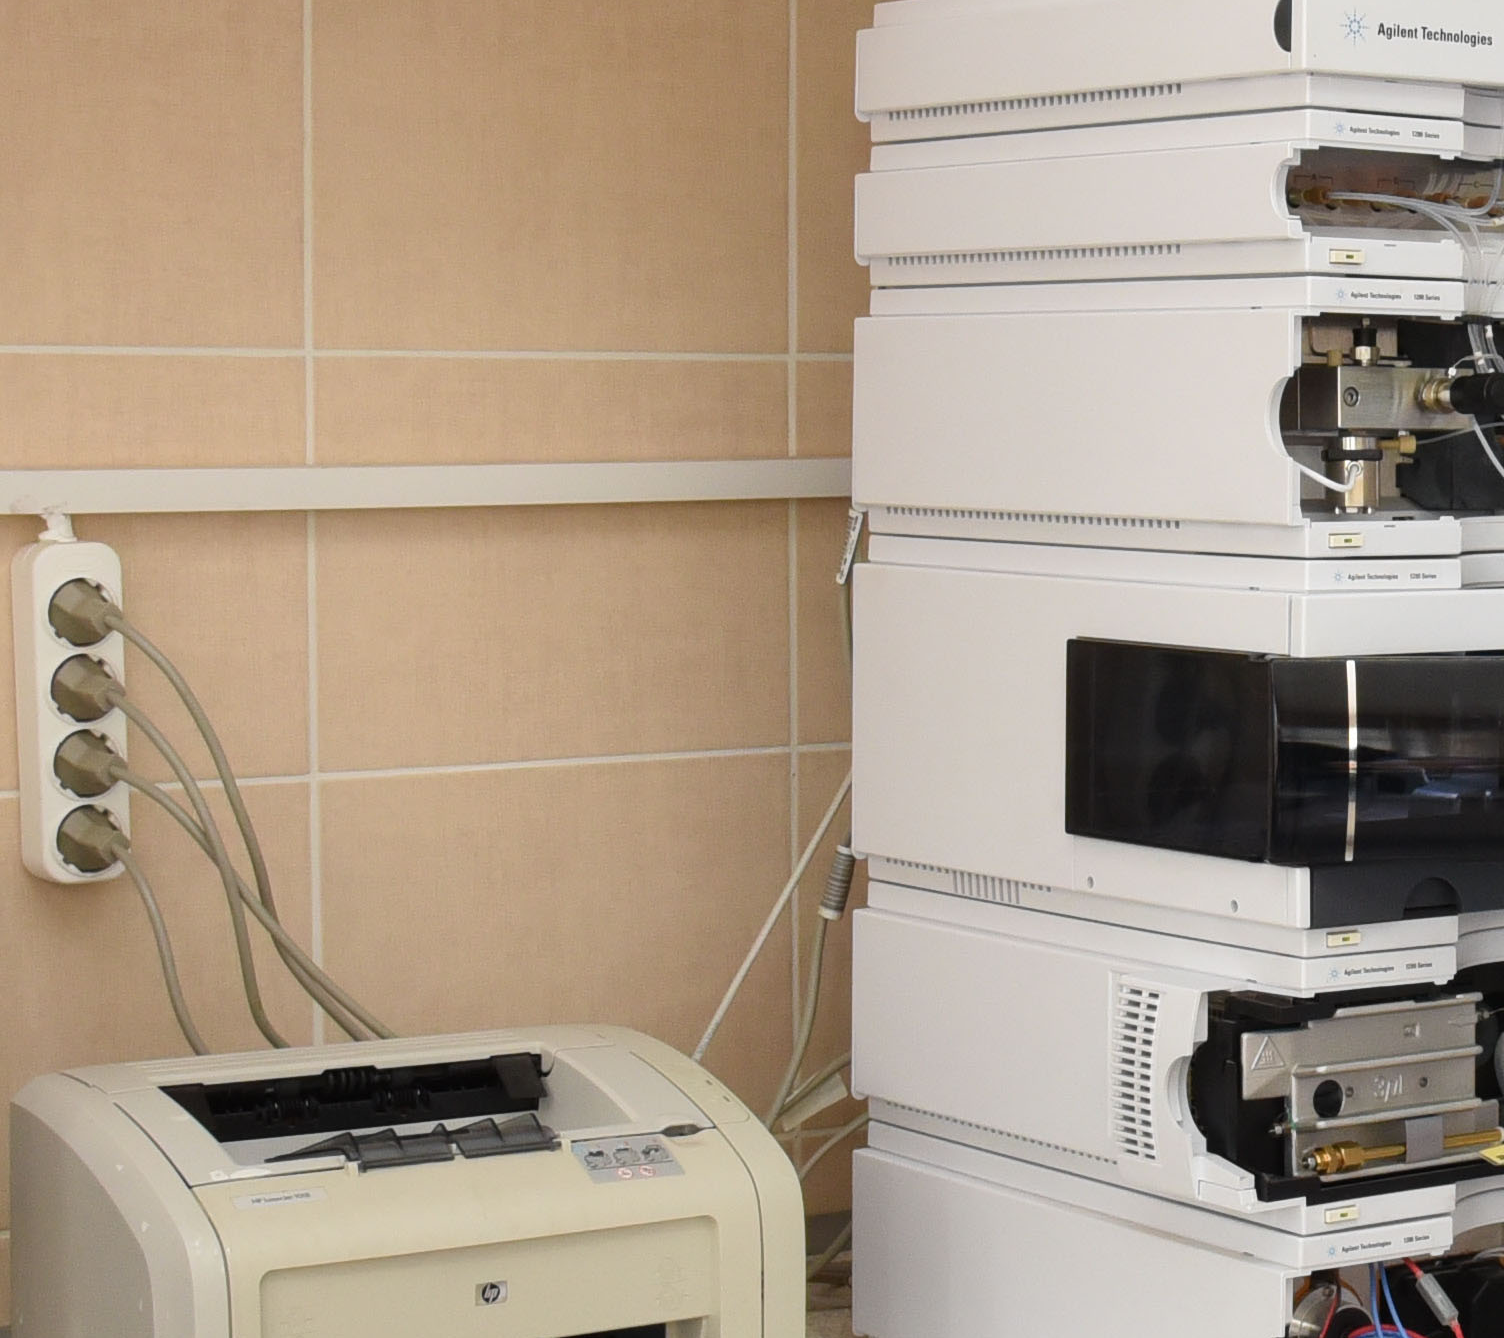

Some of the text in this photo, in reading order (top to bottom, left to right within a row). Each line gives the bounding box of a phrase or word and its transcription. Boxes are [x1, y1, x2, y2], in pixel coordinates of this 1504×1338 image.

[1377, 22, 1493, 47] Agilent Technologies
[1349, 125, 1367, 136] Agilent
[1368, 127, 1400, 137] Technologies
[1350, 290, 1368, 300] Agilent
[1369, 292, 1401, 301] Technologies
[1348, 573, 1365, 581] Agilent
[1367, 573, 1398, 581] Technologies
[1344, 969, 1361, 977] Agilent
[1363, 966, 1394, 974] Technologies
[1341, 1245, 1359, 1253] Agilent
[1360, 1240, 1391, 1250] Technologies
